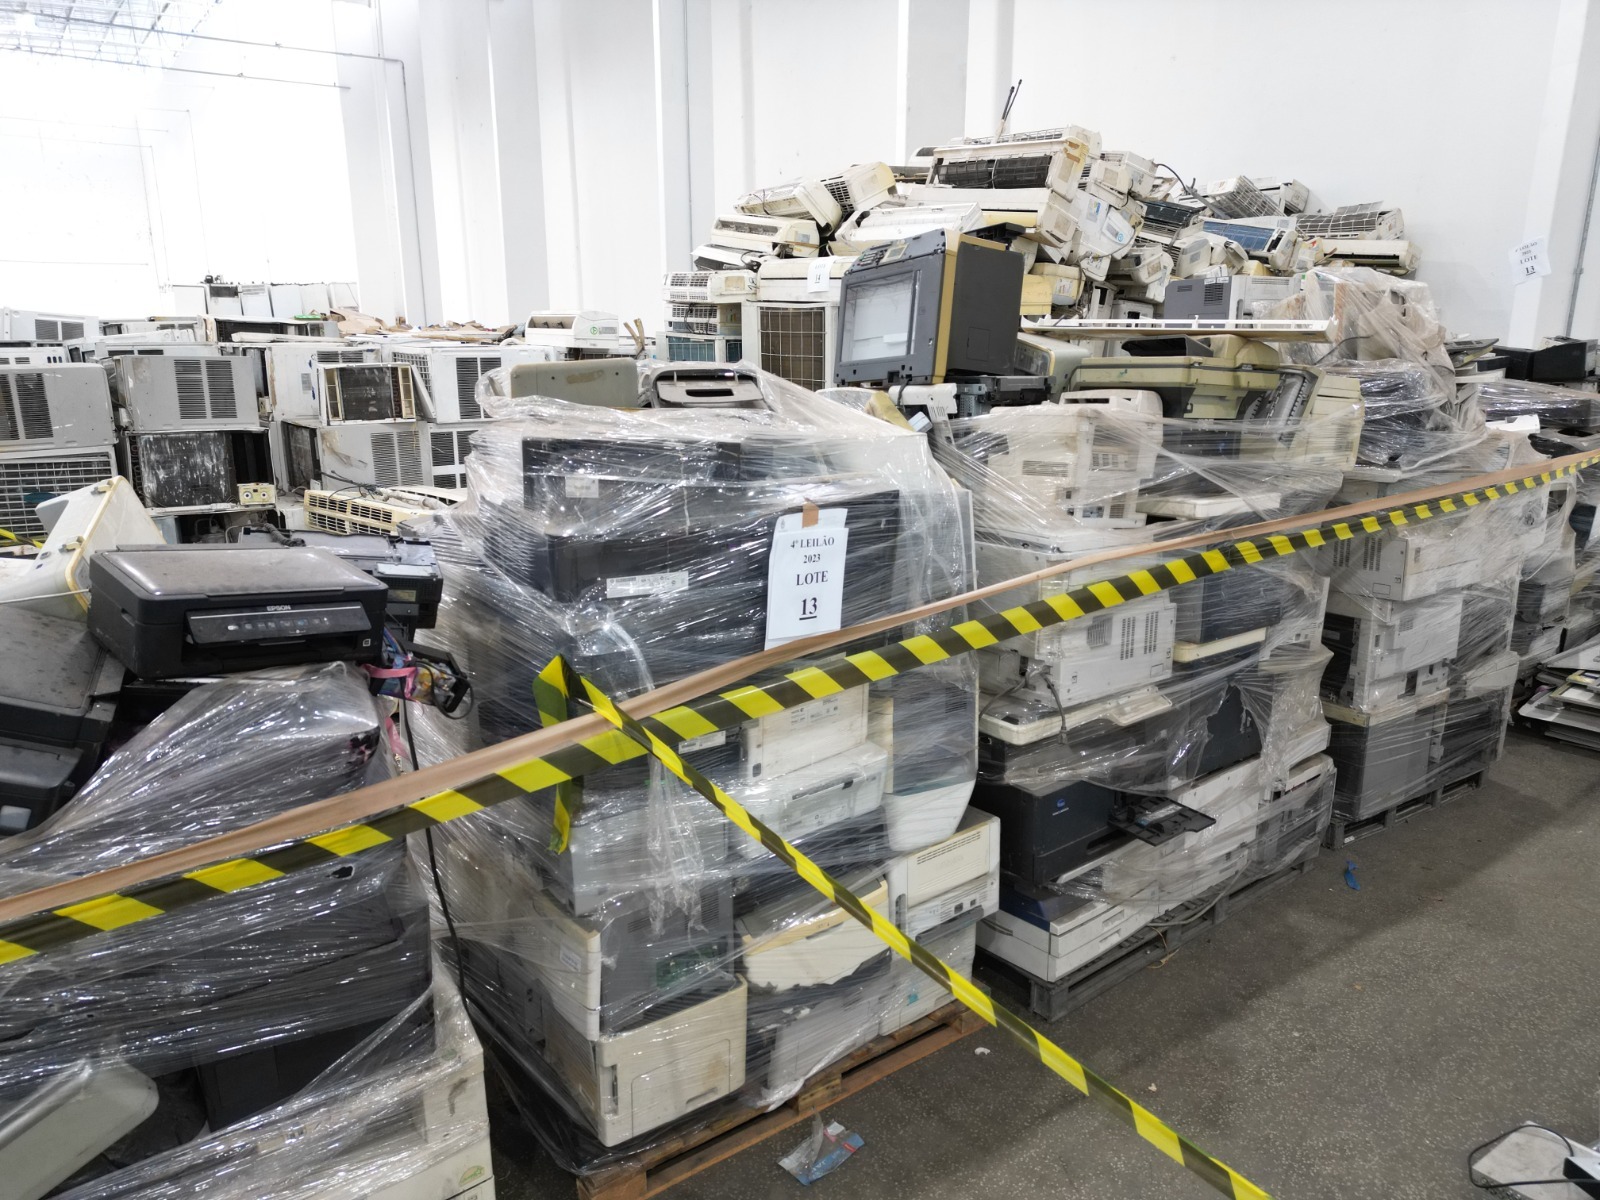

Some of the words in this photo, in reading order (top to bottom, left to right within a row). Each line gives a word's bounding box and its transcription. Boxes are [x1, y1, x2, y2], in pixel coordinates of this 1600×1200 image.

[1525, 265, 1536, 275] 13
[800, 535, 835, 549] LEILÃO
[803, 553, 821, 564] 2023
[796, 571, 829, 586] LOTE
[801, 597, 818, 616] 13
